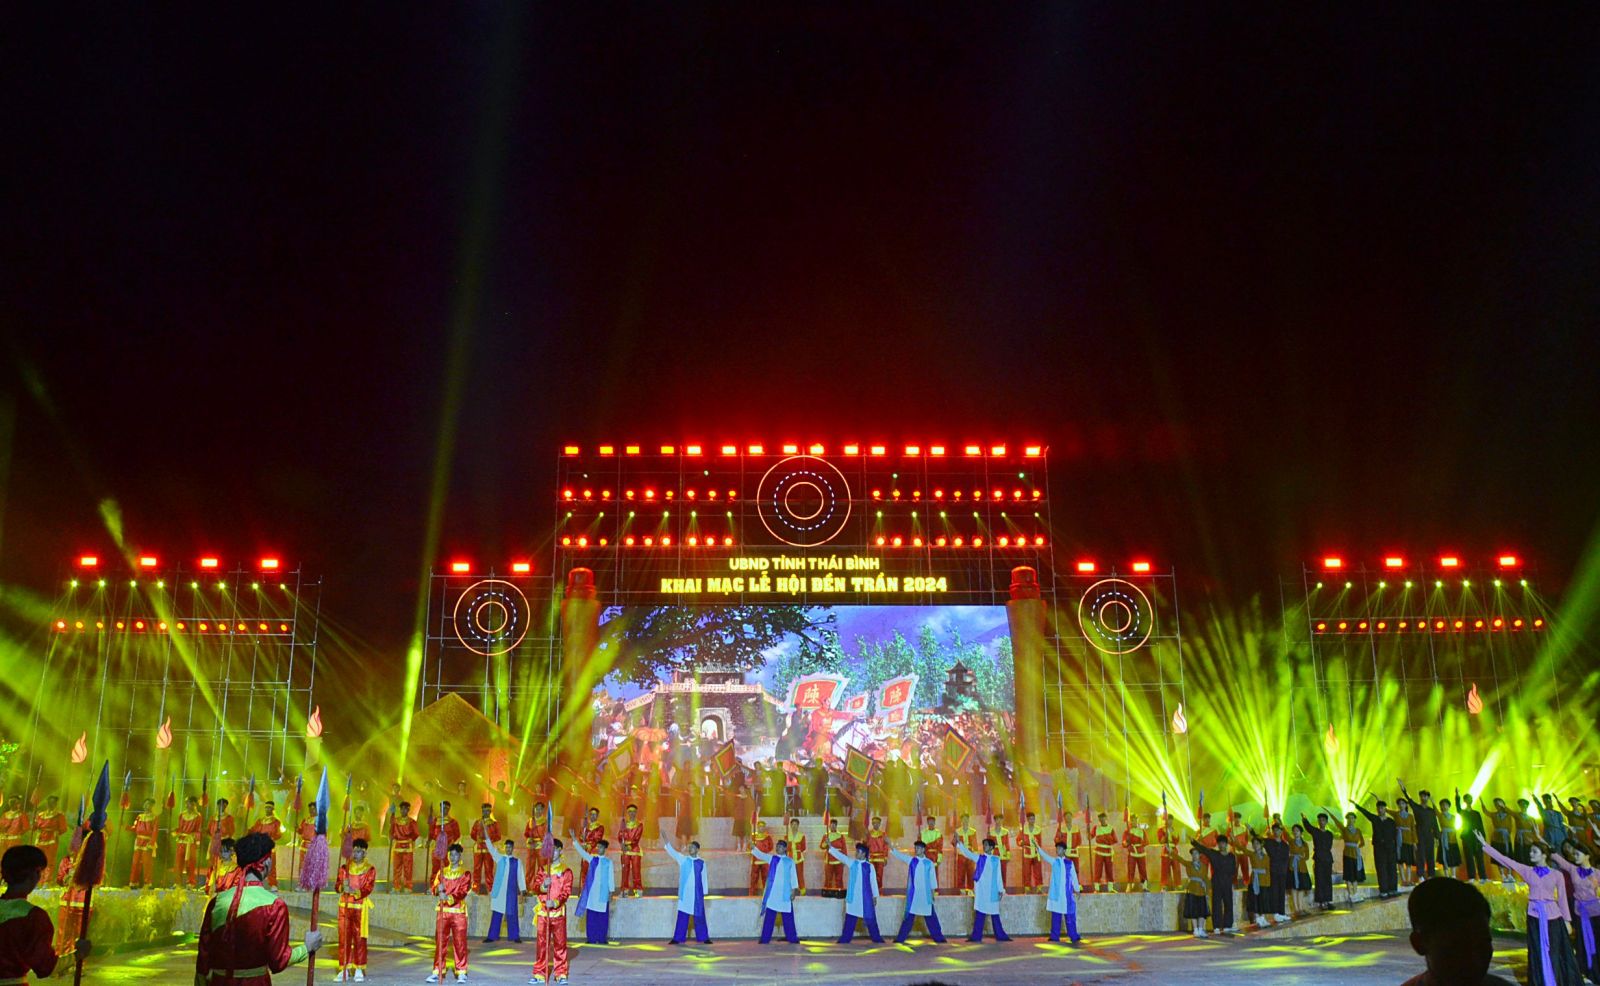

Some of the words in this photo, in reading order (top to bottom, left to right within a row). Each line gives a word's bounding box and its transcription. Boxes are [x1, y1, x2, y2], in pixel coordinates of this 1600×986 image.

[729, 558, 769, 570] UBND
[807, 555, 843, 570] THÁI
[845, 555, 880, 570] BÌNH
[660, 578, 702, 593] KHAI
[706, 577, 745, 595] MẠC
[748, 571, 771, 592] LỄ
[776, 574, 807, 595] HỘI
[903, 577, 947, 592] 2024
